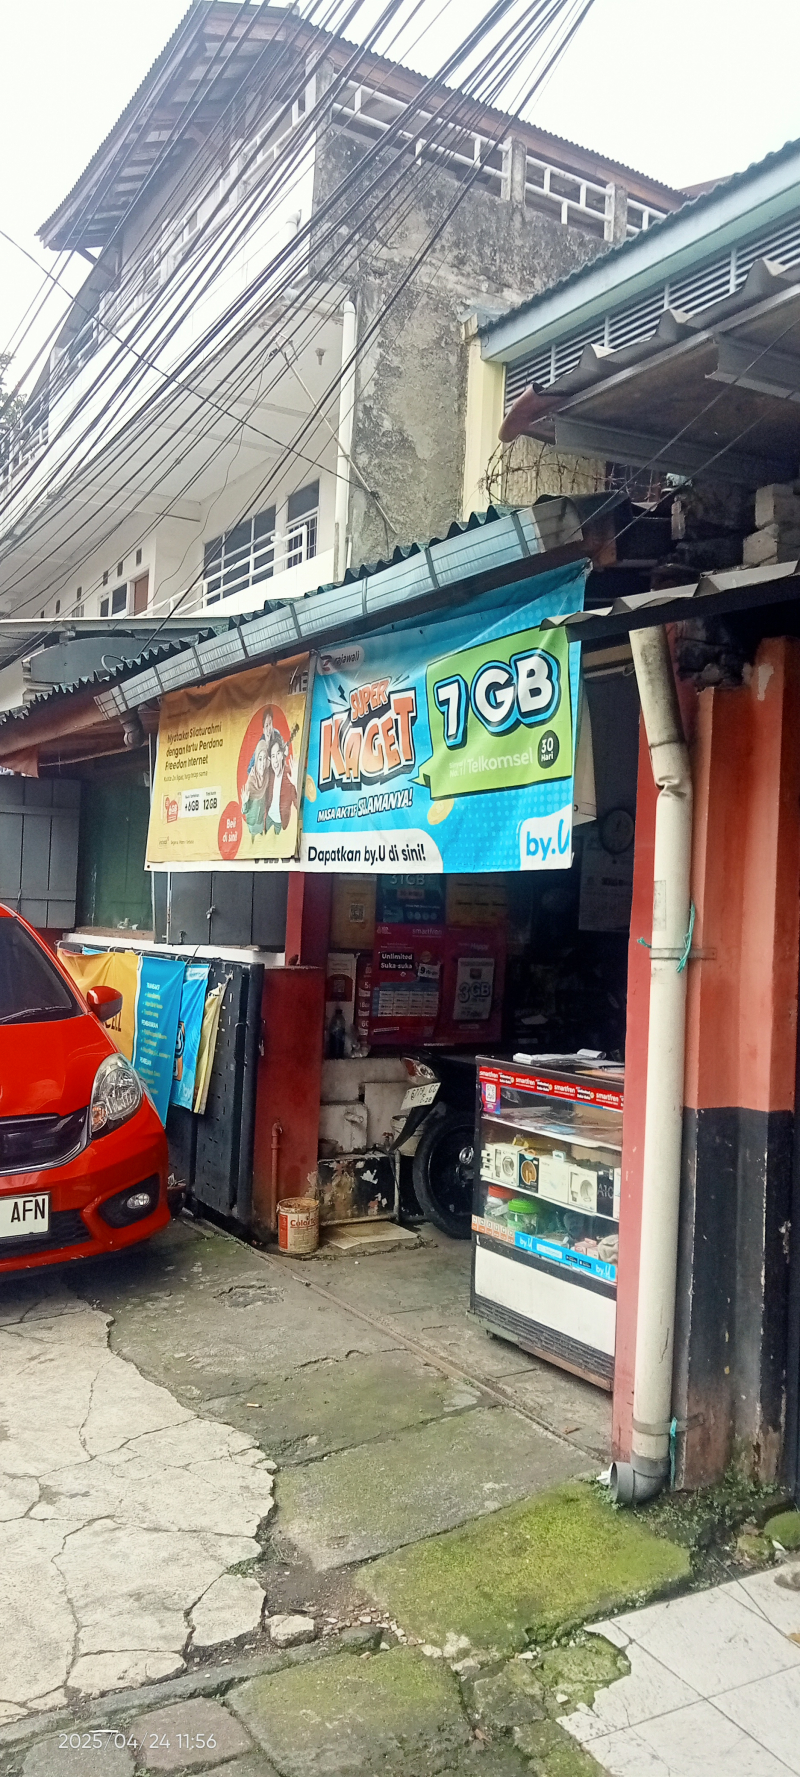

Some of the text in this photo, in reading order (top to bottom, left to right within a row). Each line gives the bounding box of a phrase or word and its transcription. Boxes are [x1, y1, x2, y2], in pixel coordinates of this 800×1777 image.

[335, 650, 361, 667] rajawali
[472, 650, 558, 731] GB
[350, 678, 391, 721] SUPER
[189, 722, 222, 739] Silaturahmi
[320, 692, 415, 780] KAGET
[165, 747, 186, 758] dengan
[199, 738, 224, 751] Perdana
[540, 738, 554, 754] 30
[466, 746, 534, 774] Telkomsel
[540, 752, 554, 762] Hari
[203, 798, 218, 811] 12GB
[317, 807, 335, 822] MASA
[308, 845, 361, 866] Dapatkan
[364, 844, 385, 866] by.U
[388, 844, 399, 861] di
[401, 843, 426, 862] sini!
[381, 952, 412, 961] Unlimited
[458, 981, 471, 1003] 3
[470, 981, 491, 998] GB
[554, 1084, 576, 1094] smartfren
[596, 1092, 619, 1102] smartfren
[10, 1197, 46, 1223] AFN
